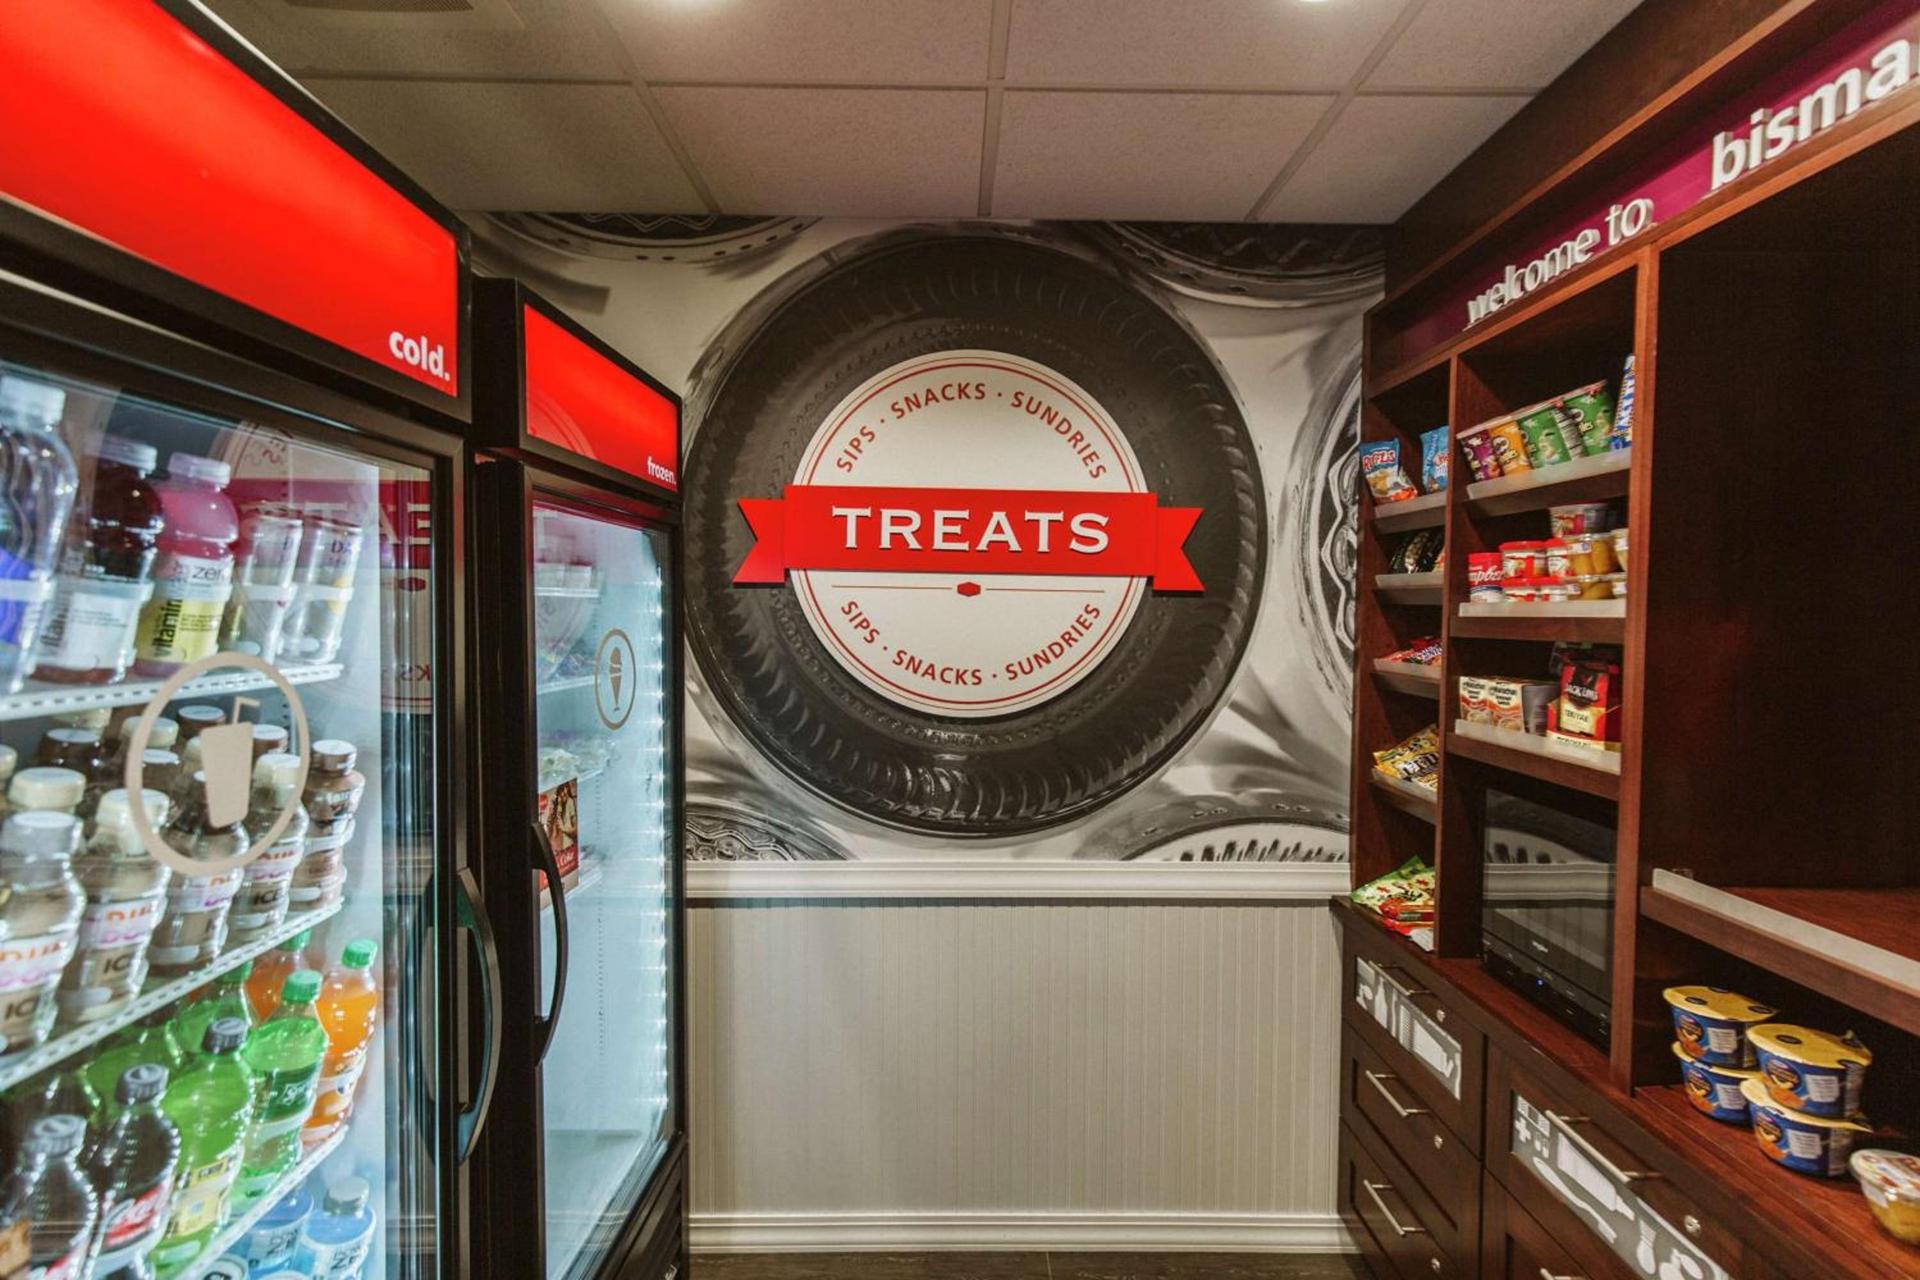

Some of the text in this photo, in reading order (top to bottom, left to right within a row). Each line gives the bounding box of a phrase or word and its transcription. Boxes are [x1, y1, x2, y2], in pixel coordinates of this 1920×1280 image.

[1467, 38, 1920, 324] welcome to bisma
[389, 331, 450, 381] cold.
[836, 383, 1108, 480] SIPS SNACKS SUNDRIES
[647, 456, 677, 485] frozen.
[831, 506, 1110, 554] TREATS
[841, 600, 1101, 686] SIPS SNACKS SUNDRIES
